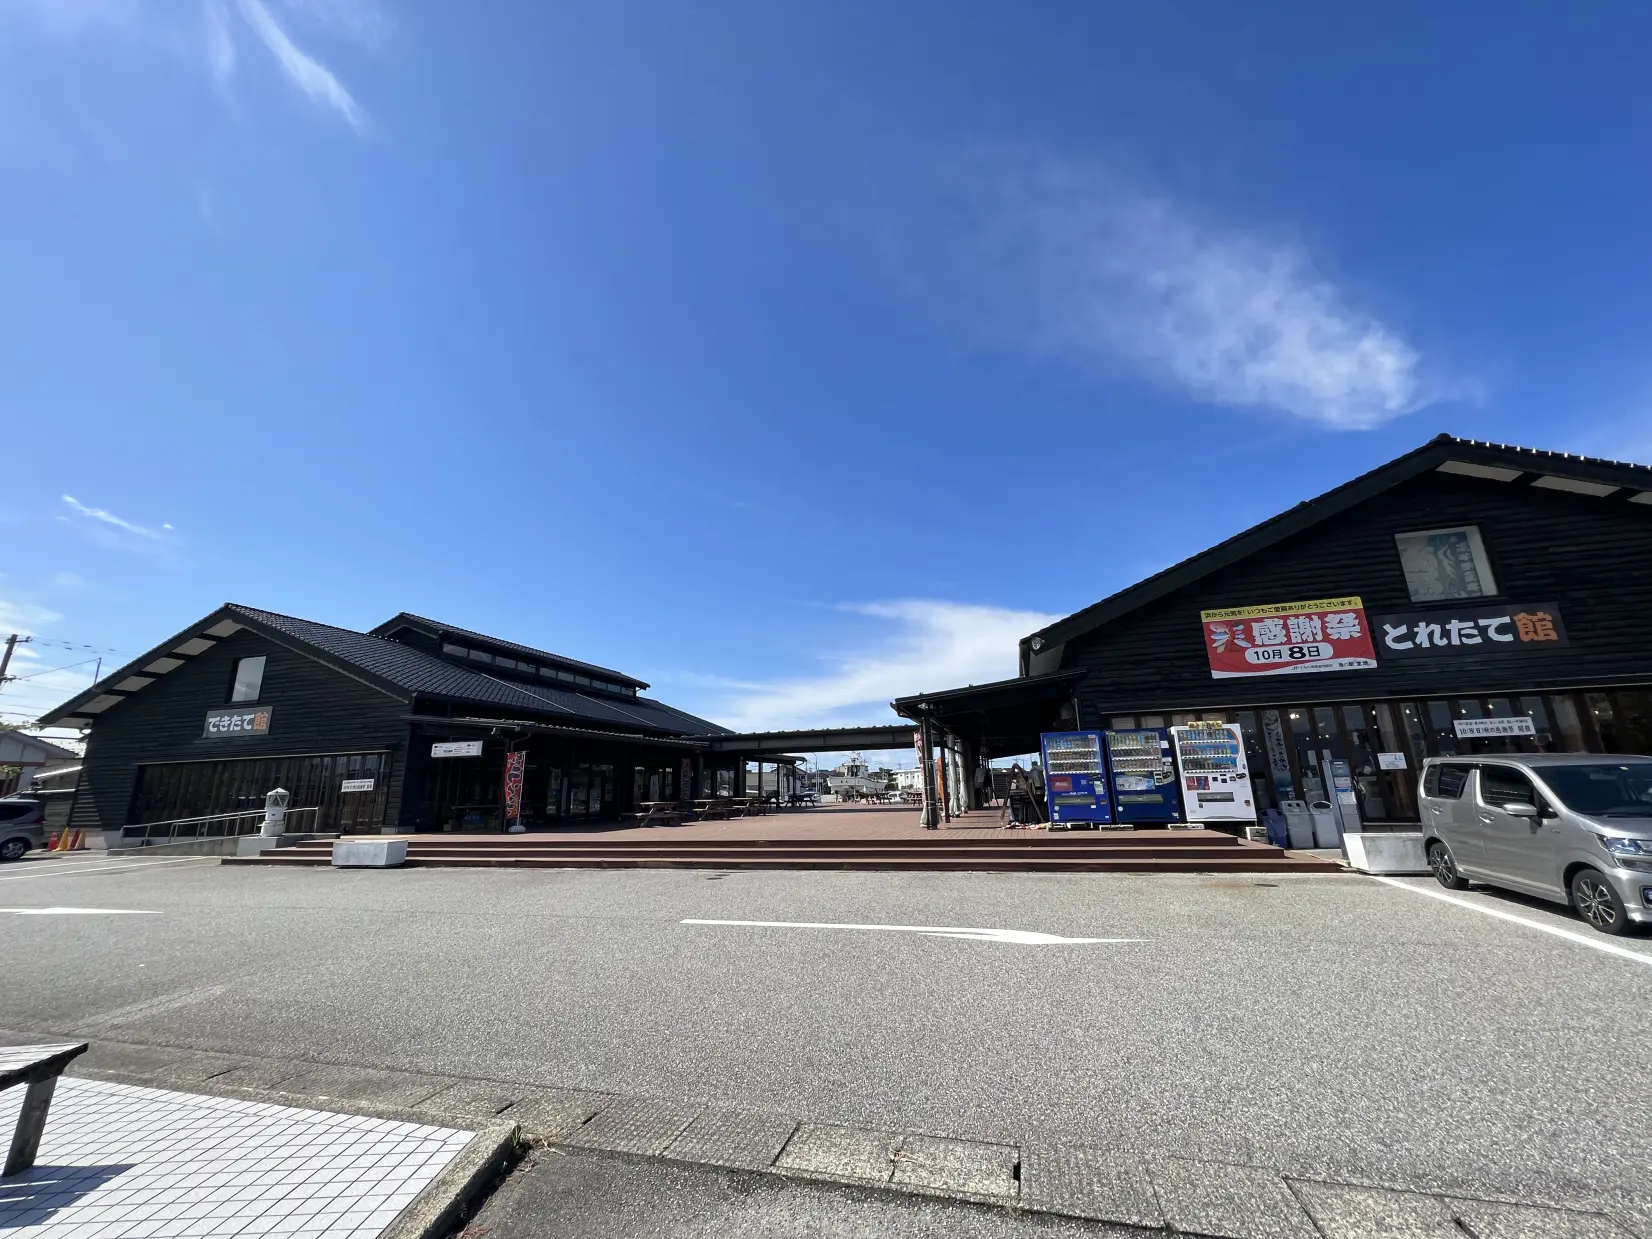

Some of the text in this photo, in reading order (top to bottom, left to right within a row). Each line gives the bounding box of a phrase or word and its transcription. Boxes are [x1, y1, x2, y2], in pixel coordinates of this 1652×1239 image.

[1251, 612, 1362, 645] 感謝祭
[1382, 611, 1559, 650] とれたて館
[208, 712, 269, 733] できたて館
